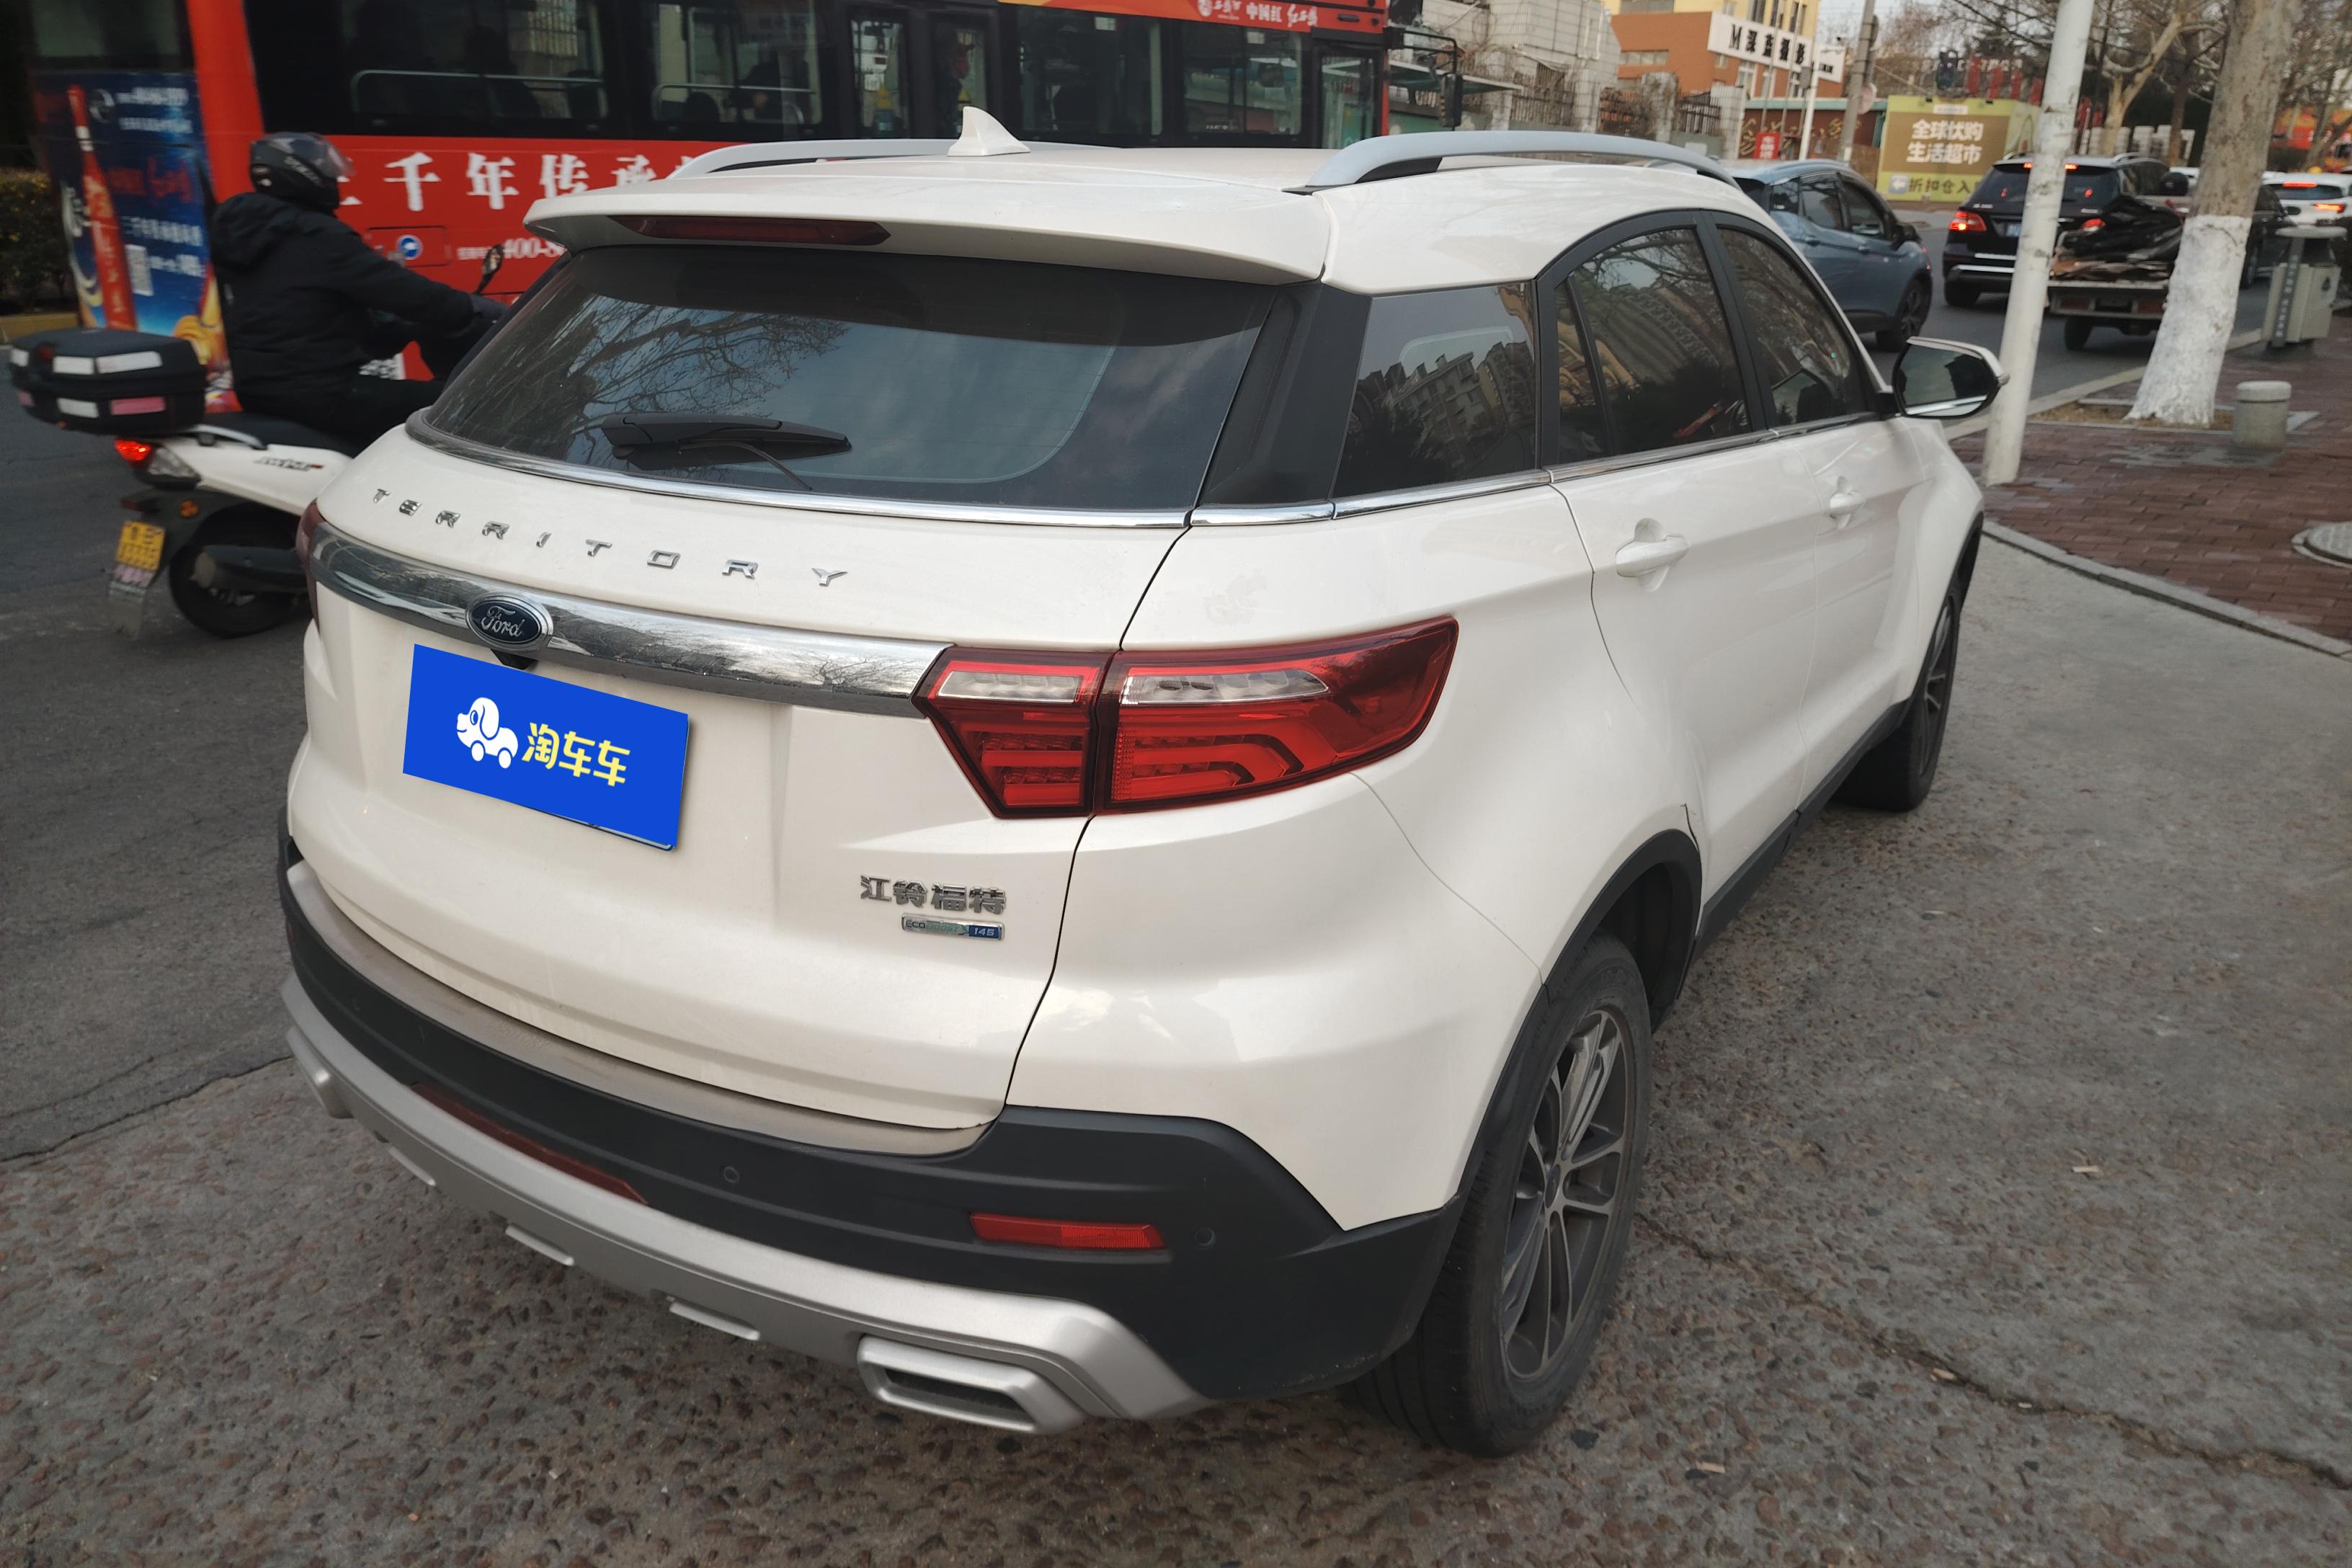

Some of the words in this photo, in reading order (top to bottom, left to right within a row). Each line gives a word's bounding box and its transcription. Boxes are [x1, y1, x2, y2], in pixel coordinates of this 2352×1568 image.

[1906, 142, 1982, 165] 生活超市
[1908, 177, 1982, 195] 折扣仓入
[373, 488, 848, 587] TERRITORY
[481, 605, 525, 638] Ford
[860, 874, 1007, 915] 江铃福特
[974, 927, 995, 937] 145
